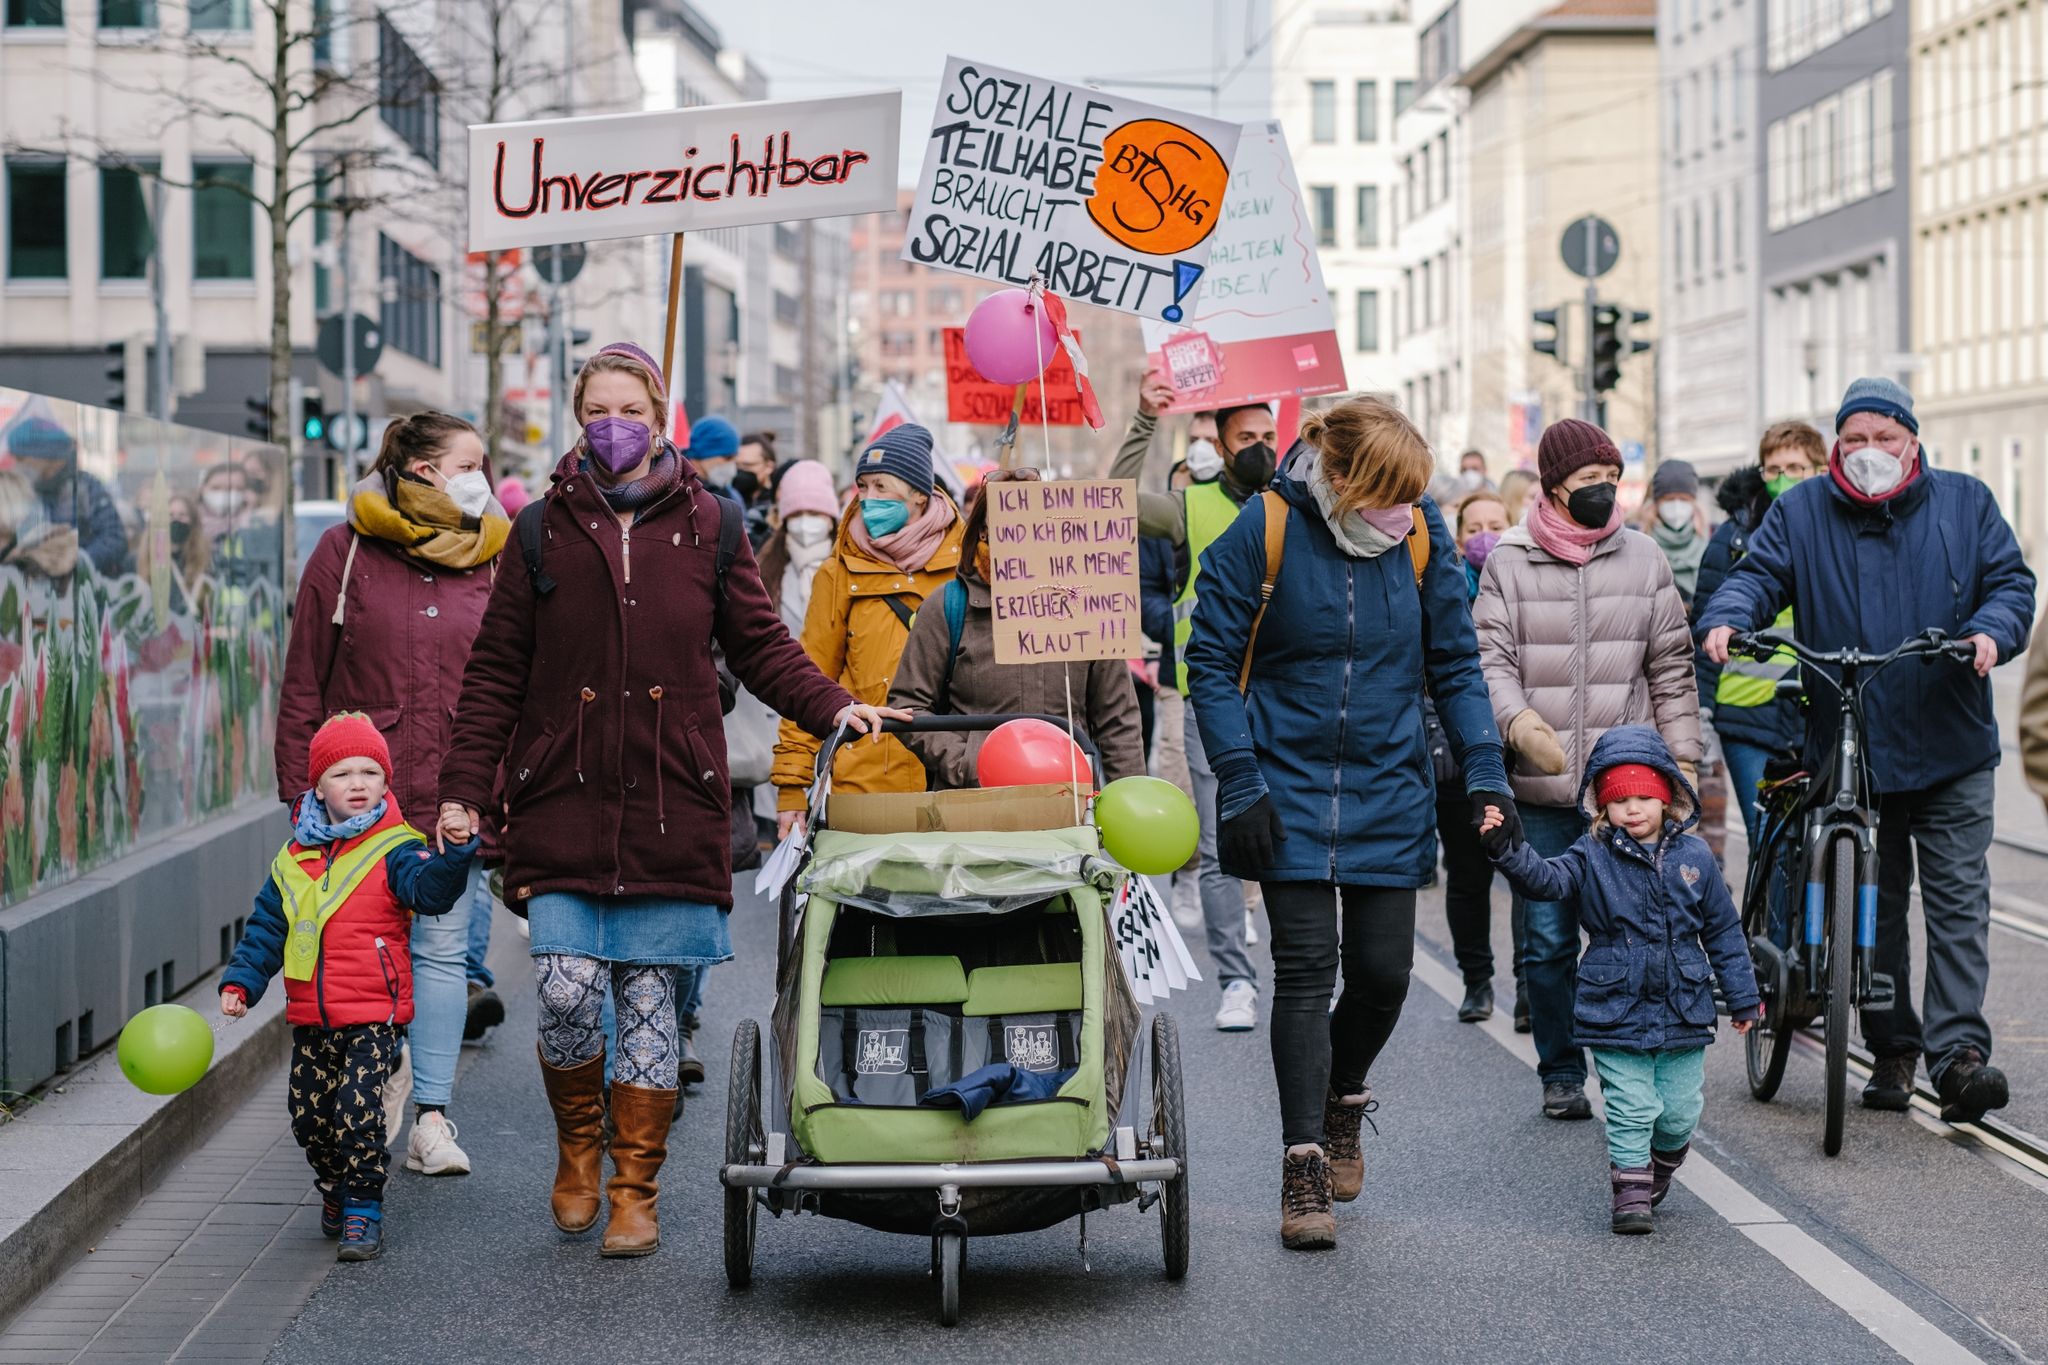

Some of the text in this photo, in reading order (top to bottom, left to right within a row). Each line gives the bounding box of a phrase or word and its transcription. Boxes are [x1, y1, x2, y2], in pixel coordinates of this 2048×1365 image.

[946, 65, 1113, 151] SOZIALE
[493, 131, 869, 220] Unverzichtbar
[931, 121, 1103, 196] TEILHABE
[931, 169, 1081, 232] BRAUCHT
[995, 523, 1027, 544] UND
[1061, 520, 1089, 545] BIN
[1094, 516, 1137, 545] LAUT,
[998, 485, 1124, 513] ICH BIN HIER
[993, 551, 1134, 582] WEIL IHR MEINE
